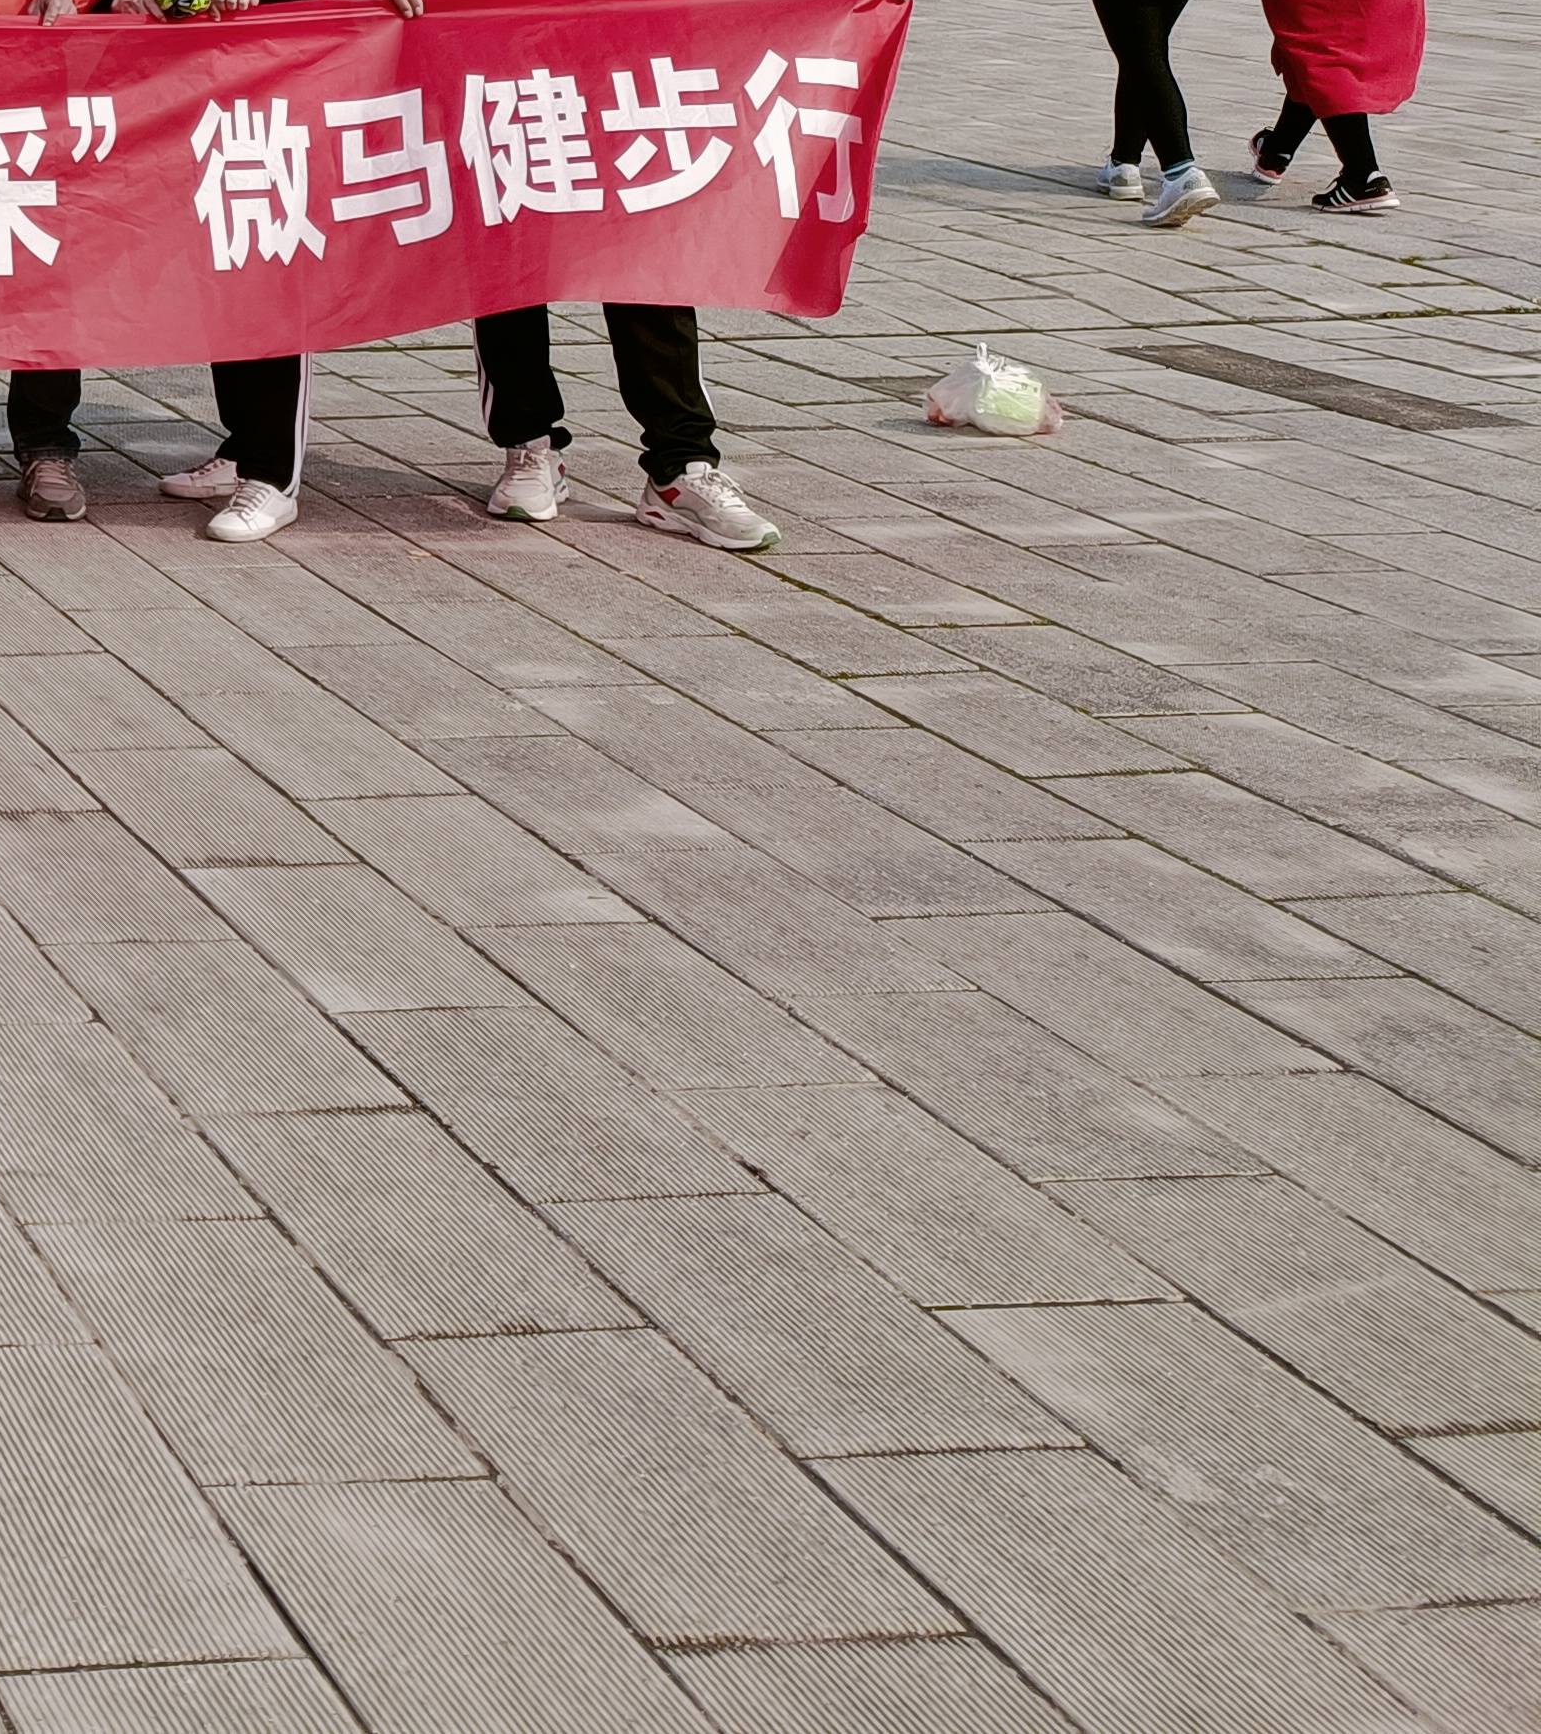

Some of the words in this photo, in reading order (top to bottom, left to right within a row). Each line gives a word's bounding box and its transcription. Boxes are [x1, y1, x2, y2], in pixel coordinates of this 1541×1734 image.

[189, 49, 863, 271] 微马健步行
